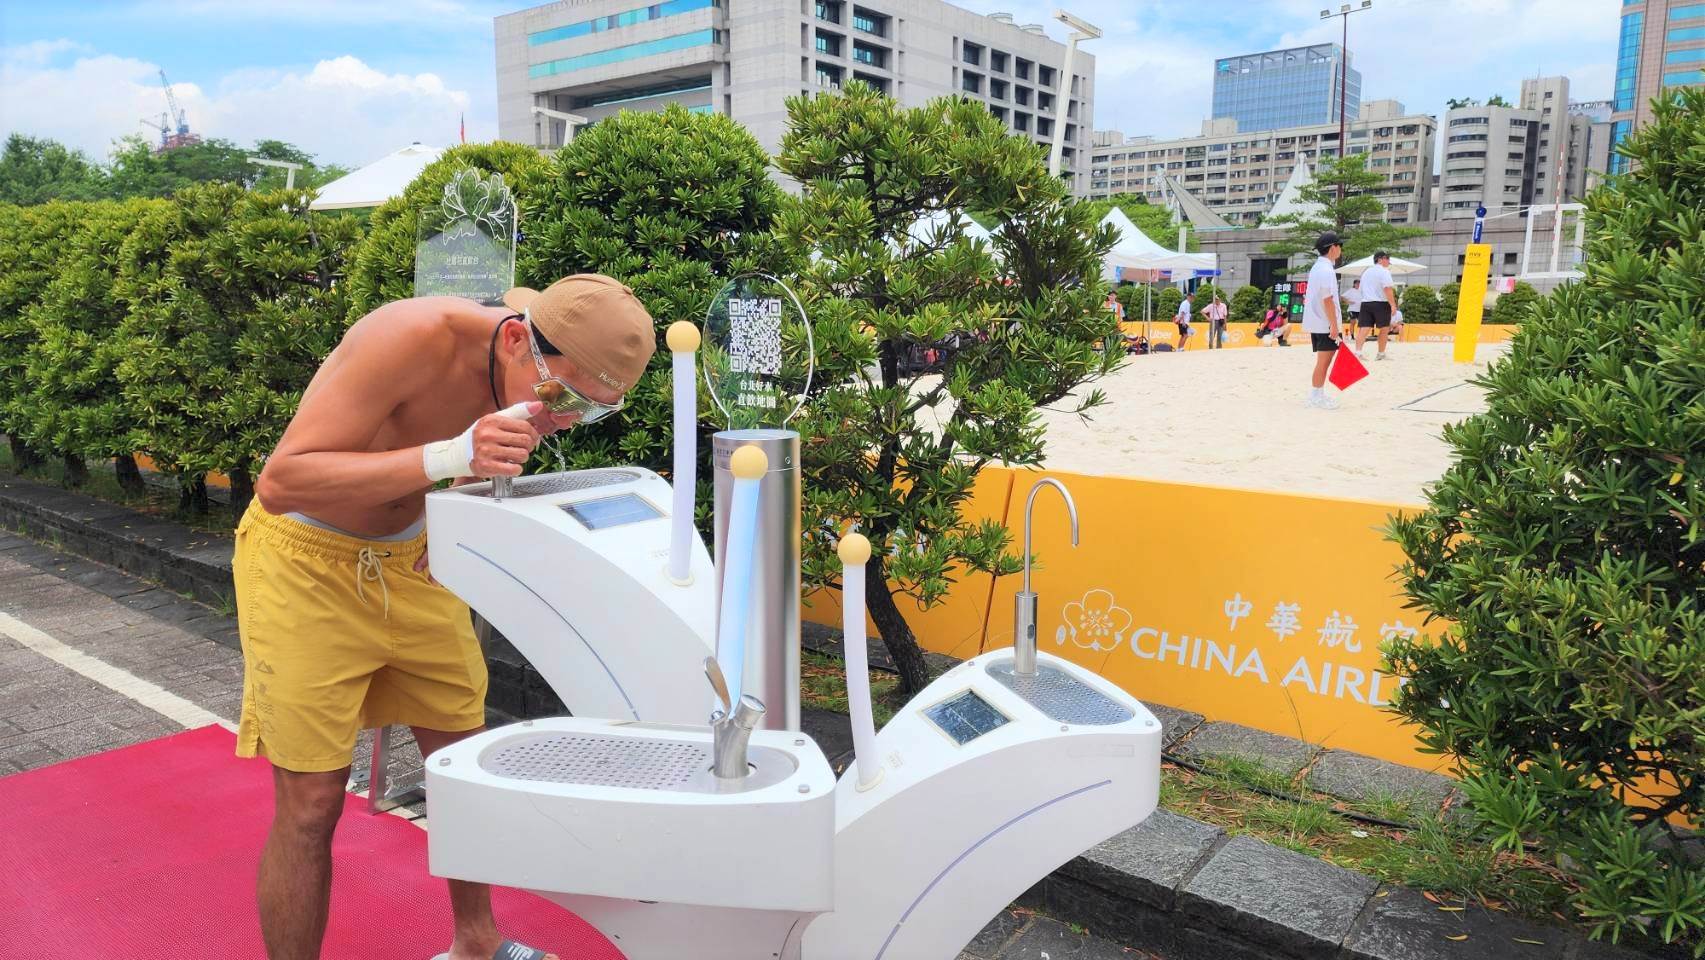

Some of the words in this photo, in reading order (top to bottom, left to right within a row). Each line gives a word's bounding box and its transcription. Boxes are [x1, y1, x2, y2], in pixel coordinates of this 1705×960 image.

[740, 379, 774, 393] 台北好水
[737, 393, 776, 409] 直飲地圖
[1130, 627, 1269, 684] CHINA
[1280, 656, 1407, 707] AIRL
